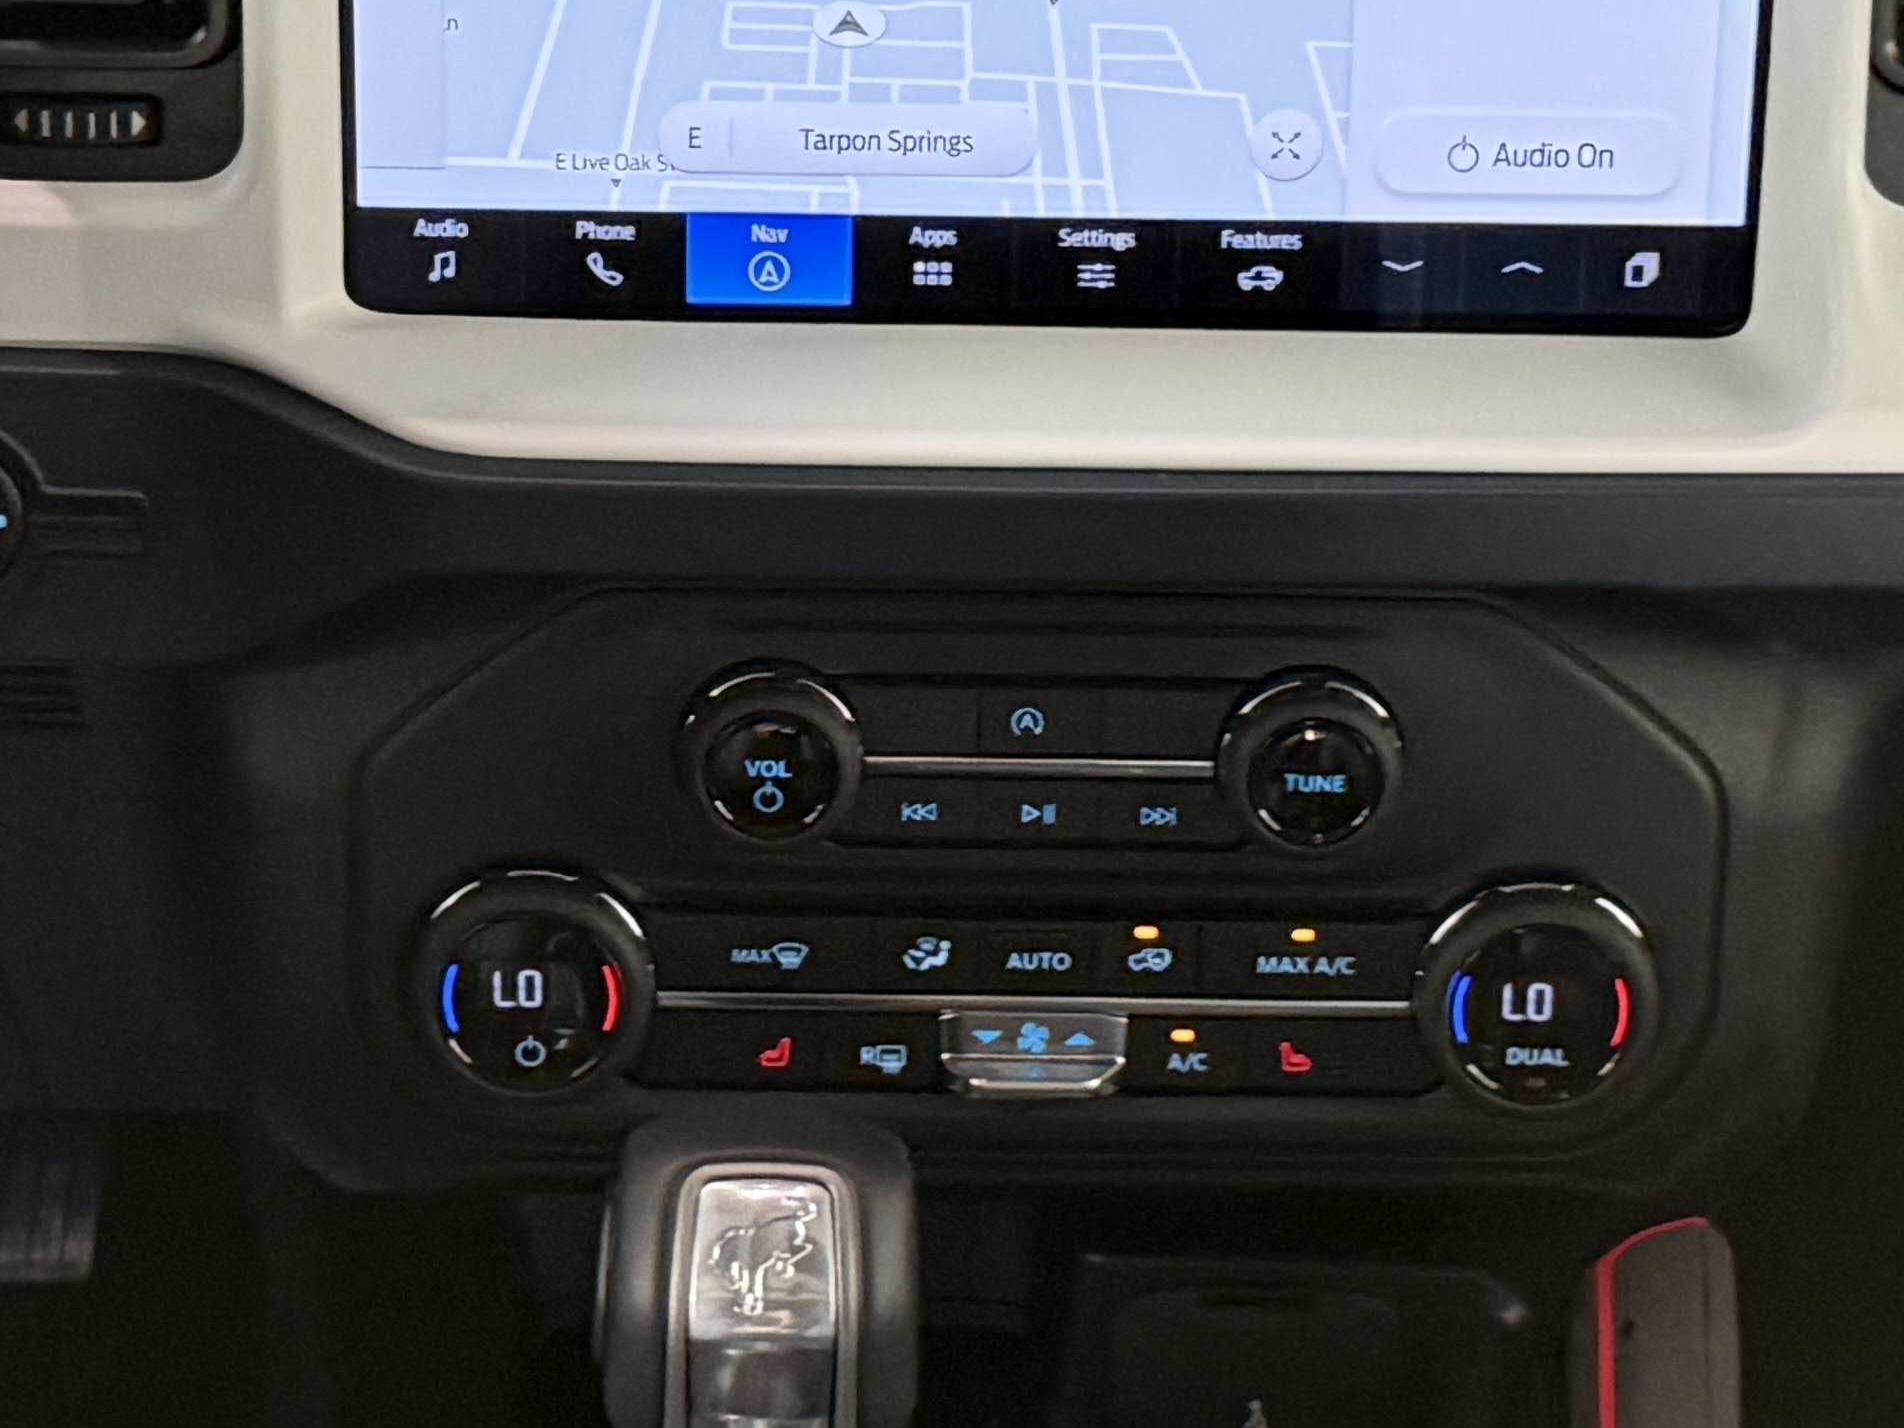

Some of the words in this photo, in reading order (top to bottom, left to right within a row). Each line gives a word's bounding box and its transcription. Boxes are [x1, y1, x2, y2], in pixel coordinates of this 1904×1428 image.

[688, 128, 701, 150] E
[799, 128, 882, 154] Tarpon
[888, 128, 974, 157] Springs
[555, 152, 567, 171] E
[573, 152, 610, 171] Live
[615, 153, 651, 172] Oak
[1493, 143, 1569, 169] Audio
[1577, 143, 1614, 169] On
[413, 218, 469, 240] Audio
[575, 220, 637, 242] Phone
[750, 223, 789, 244] Nav
[908, 226, 958, 249] Apps
[1057, 228, 1136, 252] Settings
[1220, 229, 1303, 252] Features
[744, 759, 792, 779] VOL
[1283, 774, 1345, 794] TUNE
[731, 949, 771, 964] MAX
[1006, 952, 1072, 971] AUTO
[1256, 956, 1309, 975] MAX
[1314, 956, 1356, 976] A/C
[492, 969, 543, 1009] LO
[1501, 982, 1553, 1022] LO
[1167, 1052, 1208, 1072] A/C
[1506, 1047, 1569, 1068] DUAL
